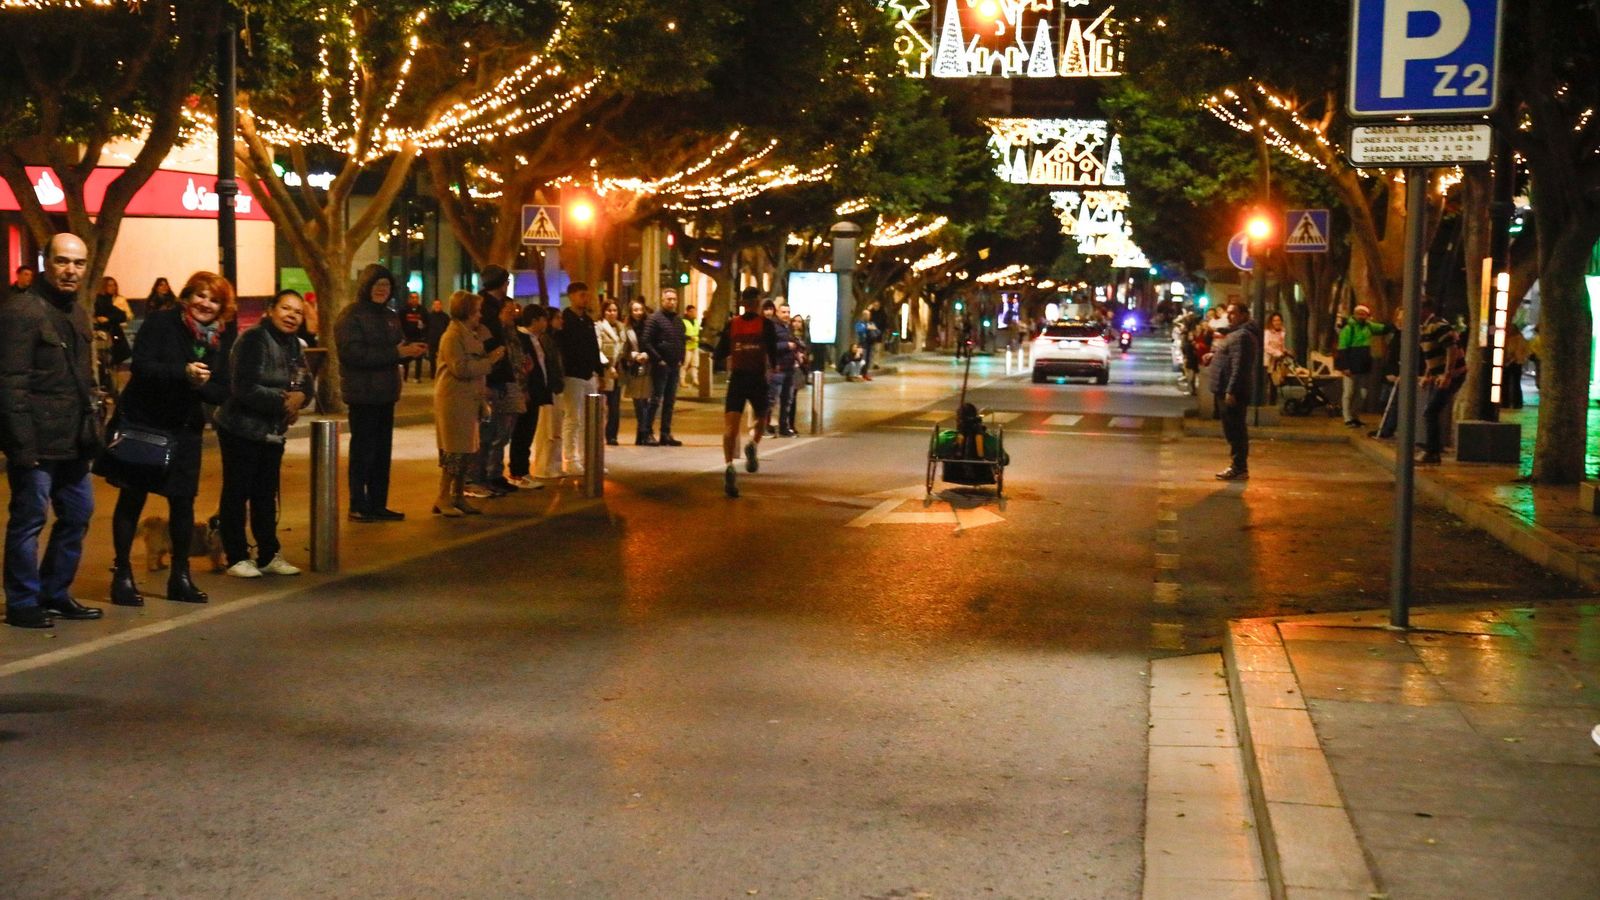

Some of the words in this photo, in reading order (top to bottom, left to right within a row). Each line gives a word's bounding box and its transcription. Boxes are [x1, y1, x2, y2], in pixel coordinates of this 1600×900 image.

[1379, 0, 1471, 99] P
[1432, 63, 1489, 97] Z2
[1363, 126, 1399, 135] CARGA
[1417, 124, 1475, 134] DESCARGA
